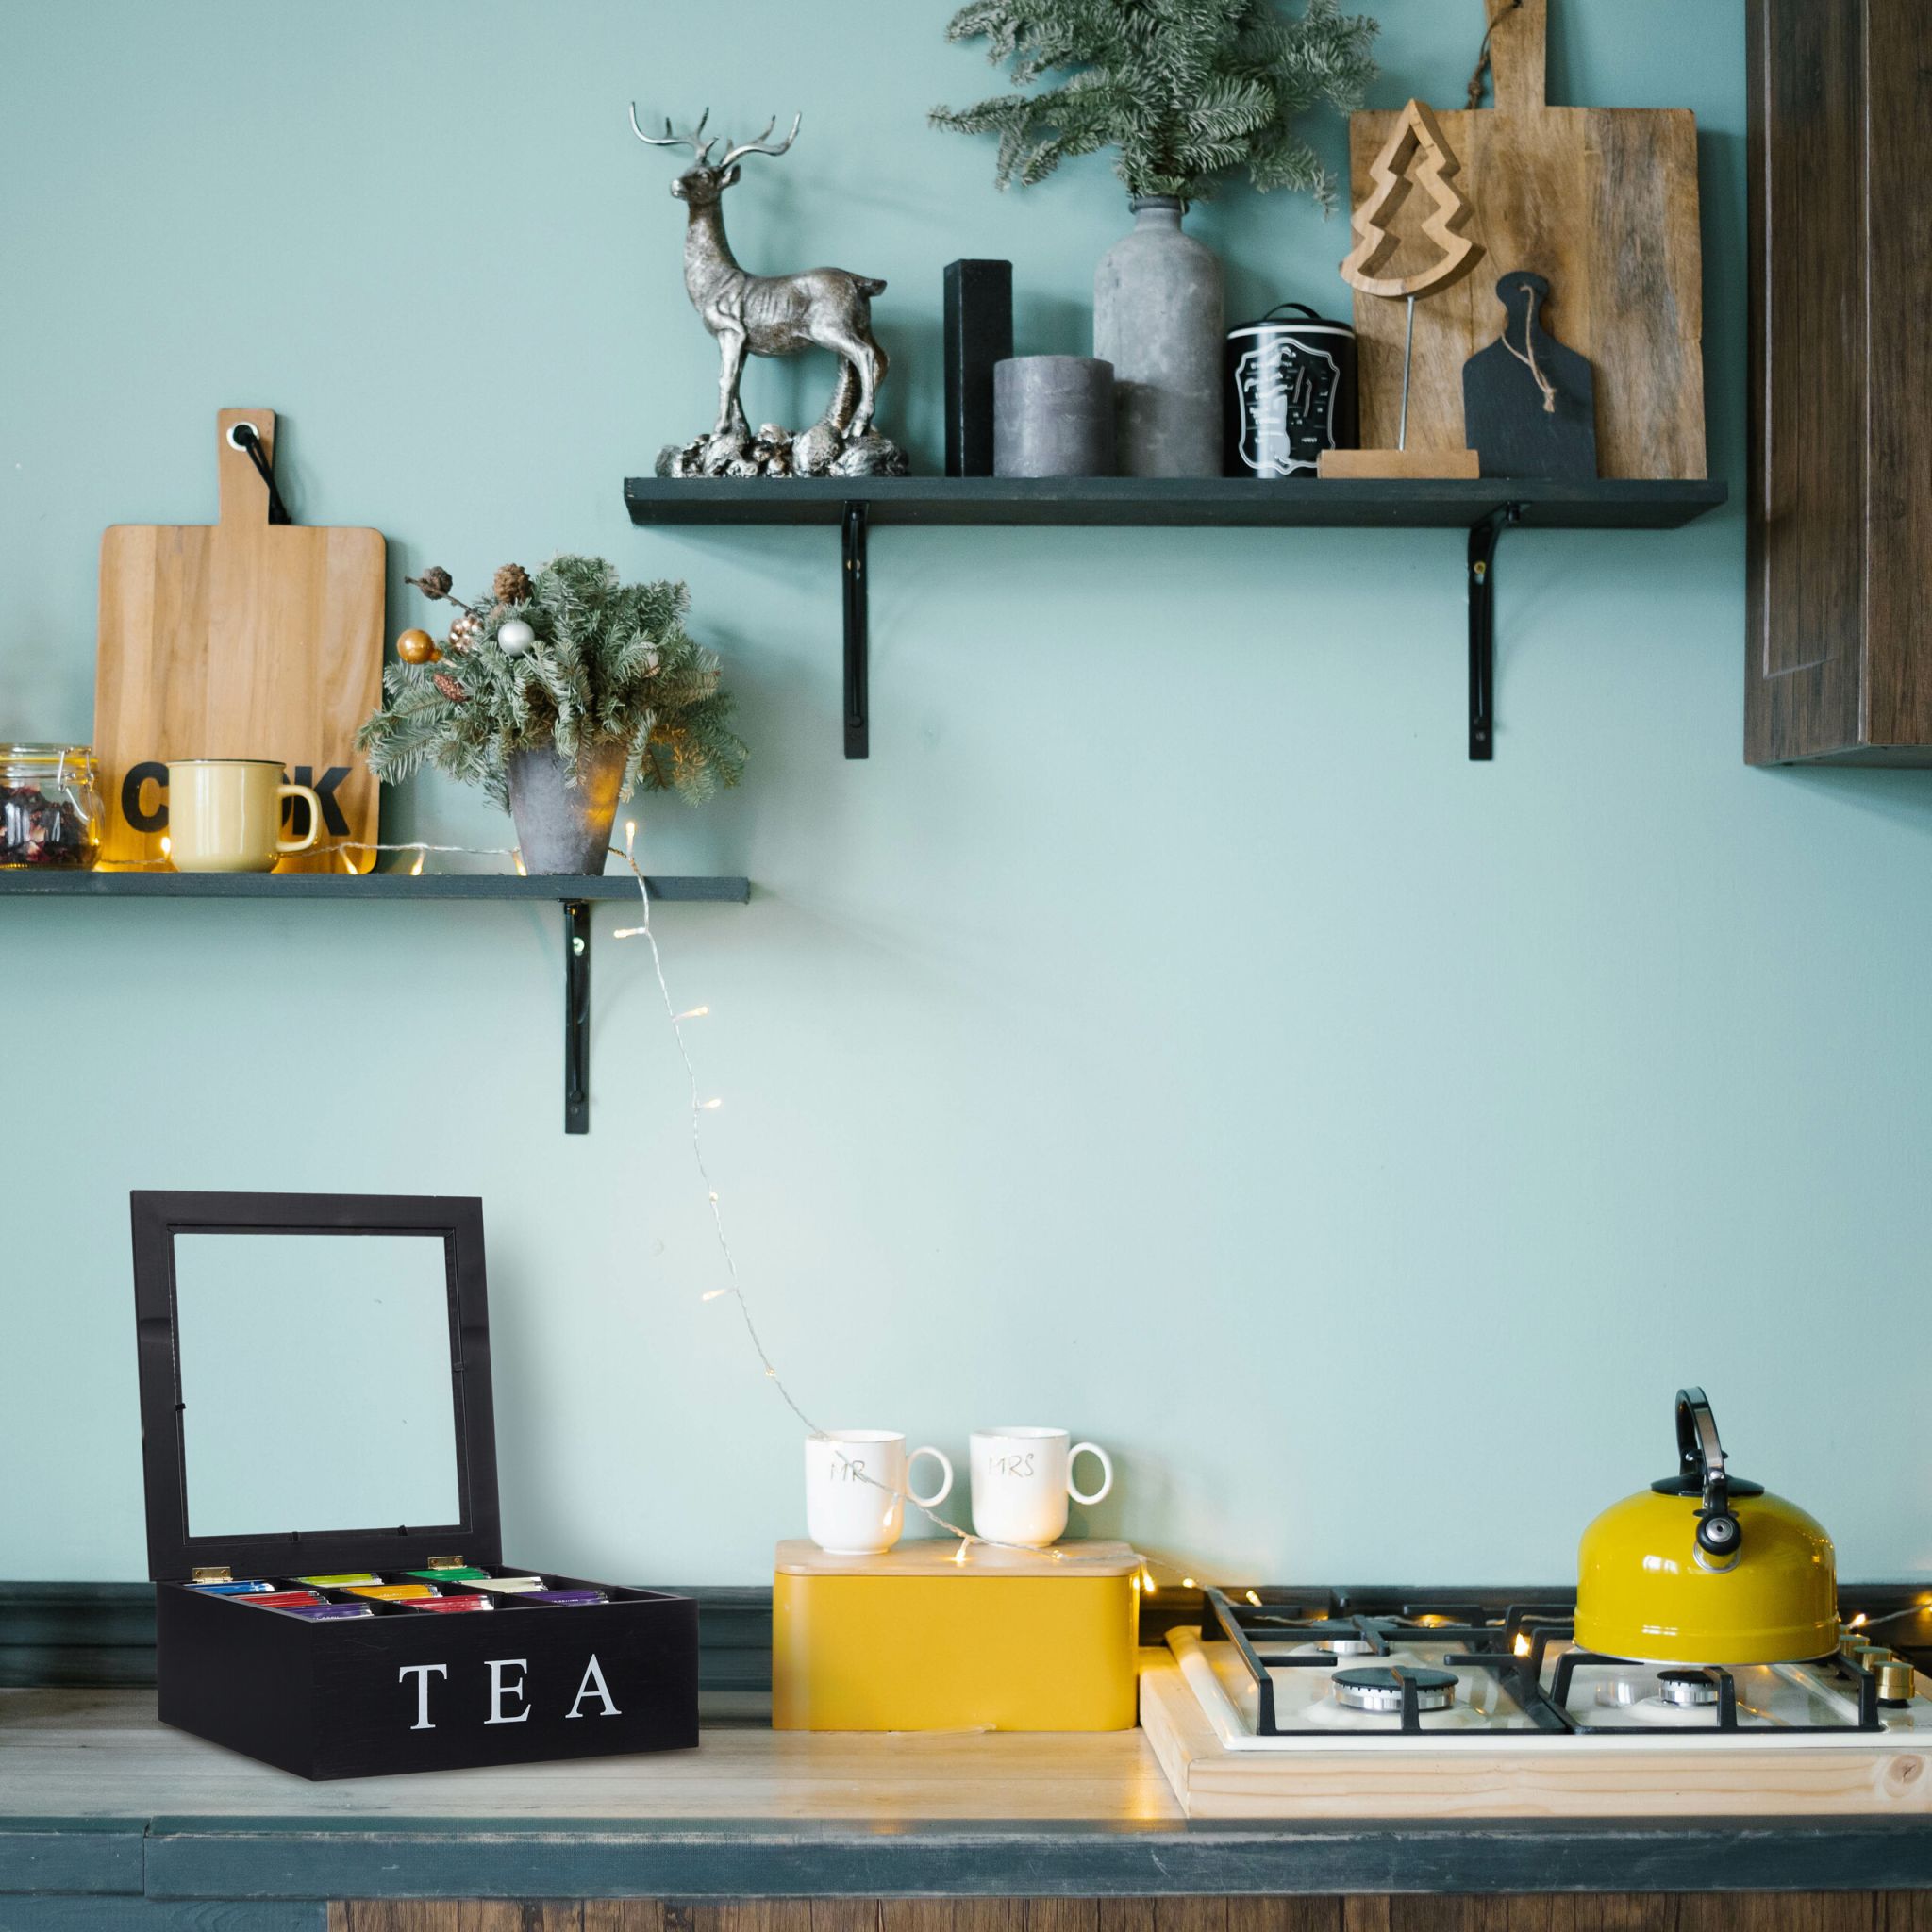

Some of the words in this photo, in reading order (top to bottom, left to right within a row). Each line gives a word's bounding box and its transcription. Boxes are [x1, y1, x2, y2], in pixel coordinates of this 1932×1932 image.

[122, 761, 353, 836] CK
[830, 1459, 867, 1482] MR
[989, 1453, 1034, 1478] MRS
[399, 1654, 623, 1730] TEA
